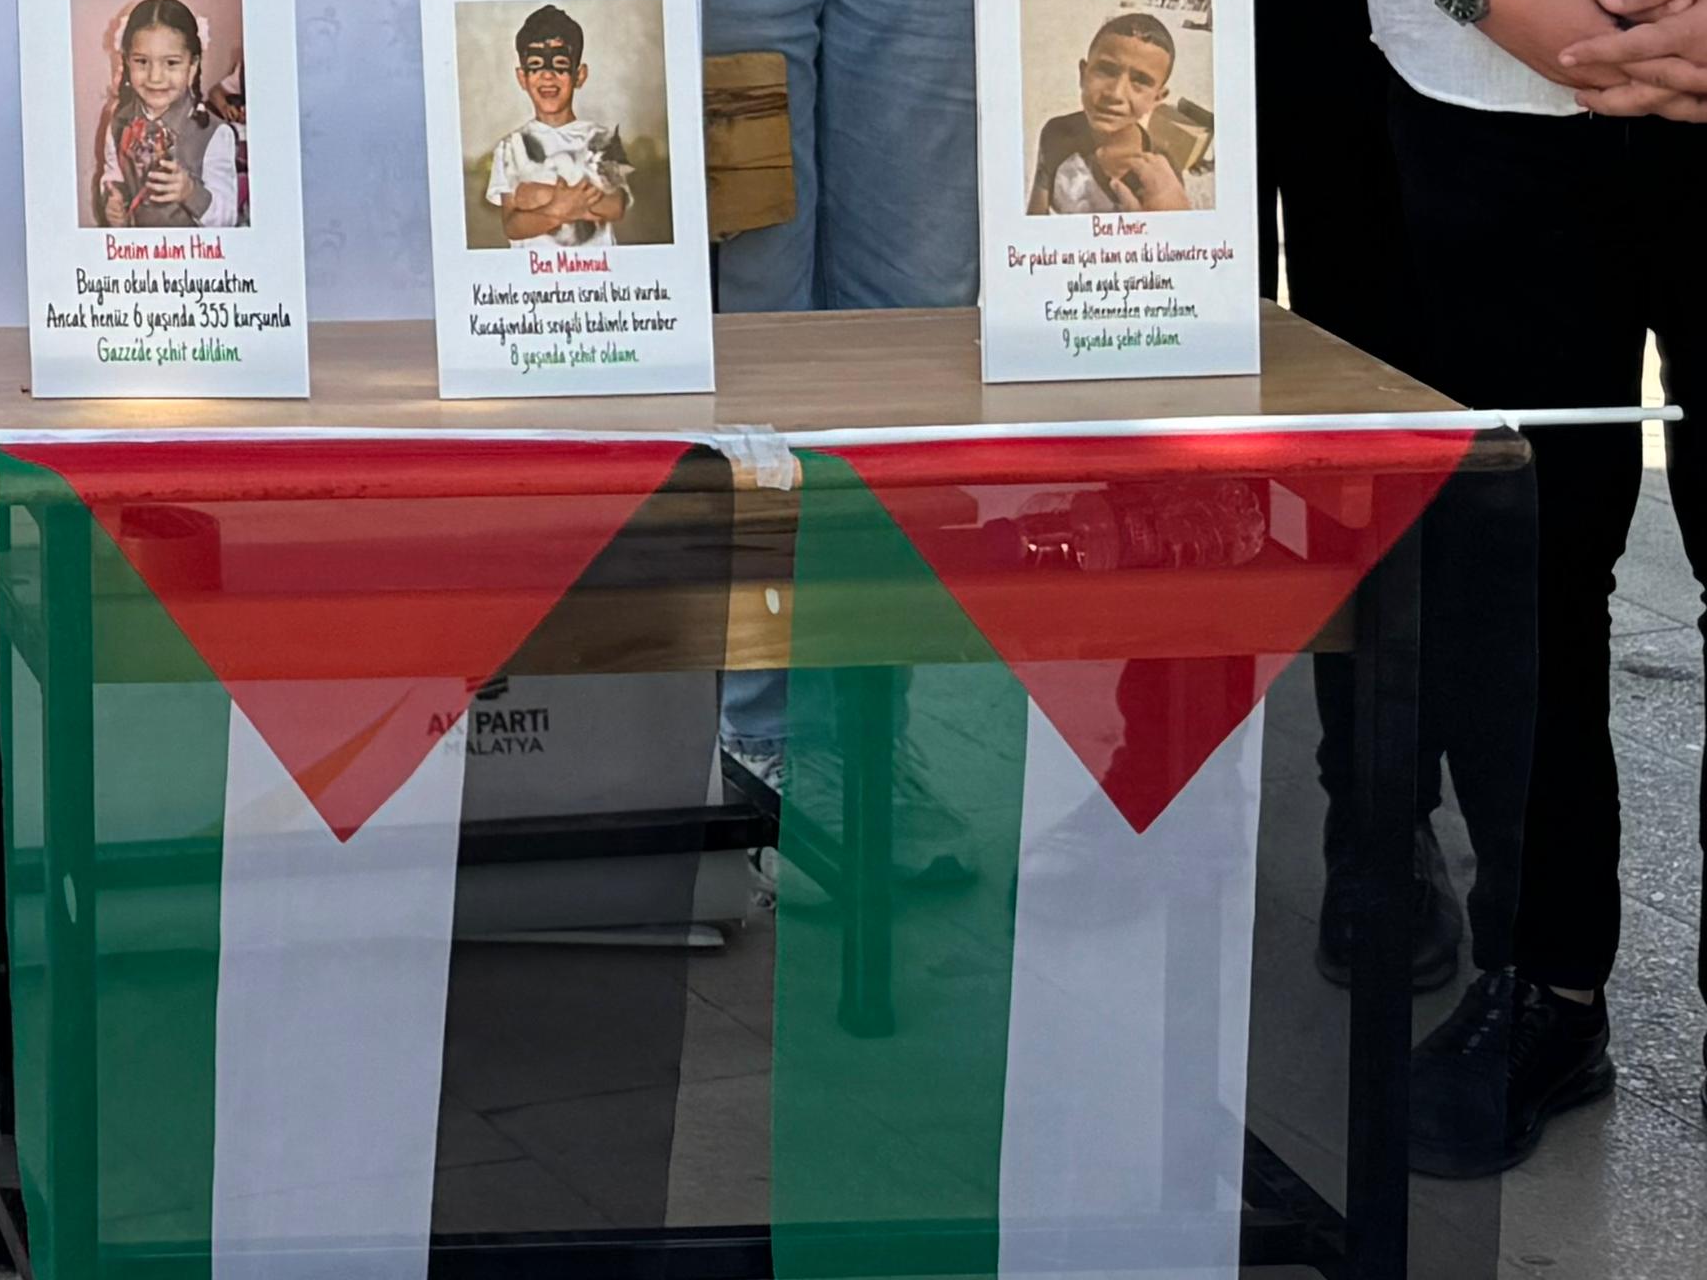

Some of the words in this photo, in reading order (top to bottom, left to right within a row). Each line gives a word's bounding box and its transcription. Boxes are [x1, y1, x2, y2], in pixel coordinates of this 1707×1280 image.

[106, 234, 148, 260] Benim
[154, 236, 185, 259] adım
[76, 268, 119, 305] Bugün
[124, 269, 158, 294] okula
[46, 303, 87, 328] Ancak
[91, 304, 129, 328] henüz
[134, 303, 142, 328] 6
[147, 303, 195, 337] yaşında
[200, 303, 229, 328] 355
[234, 303, 291, 331] kurşunla
[97, 337, 152, 363] Gazze'de
[157, 340, 187, 365] şehit
[443, 738, 544, 756] MALATYA
